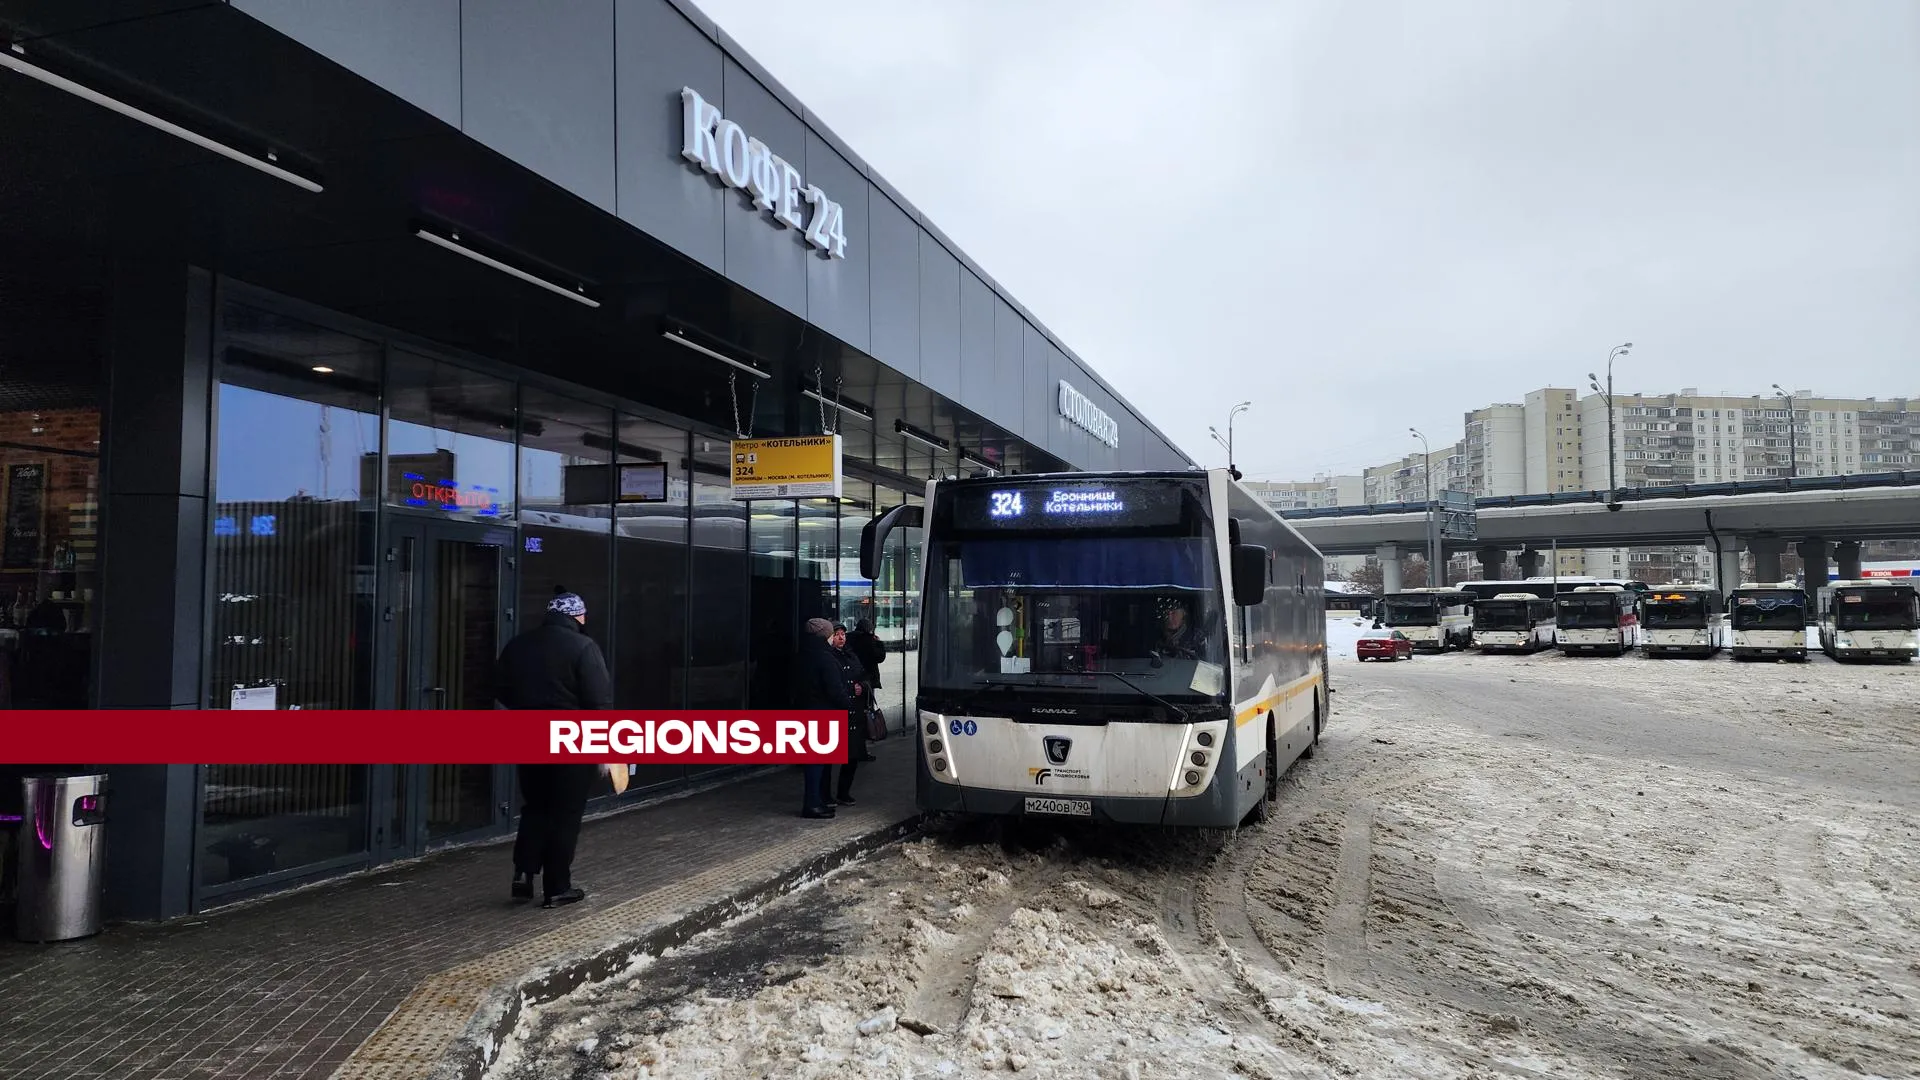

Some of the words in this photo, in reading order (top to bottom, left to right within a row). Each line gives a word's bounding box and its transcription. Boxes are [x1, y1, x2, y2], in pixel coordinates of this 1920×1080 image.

[681, 86, 801, 230] КОФЕ
[804, 184, 847, 260] 24
[1059, 380, 1107, 442] СТОЛОВАЯ
[735, 442, 759, 452] Метро
[761, 438, 831, 449] «КОТЕЛЬНИКИ»
[735, 466, 754, 476] 324
[412, 482, 491, 509] ОТКРЫТО
[1053, 491, 1116, 503] Бронницы
[991, 492, 1022, 515] 324
[1045, 501, 1123, 513] Котельники
[1032, 707, 1078, 715] KAMAZ
[1071, 801, 1089, 812] 790
